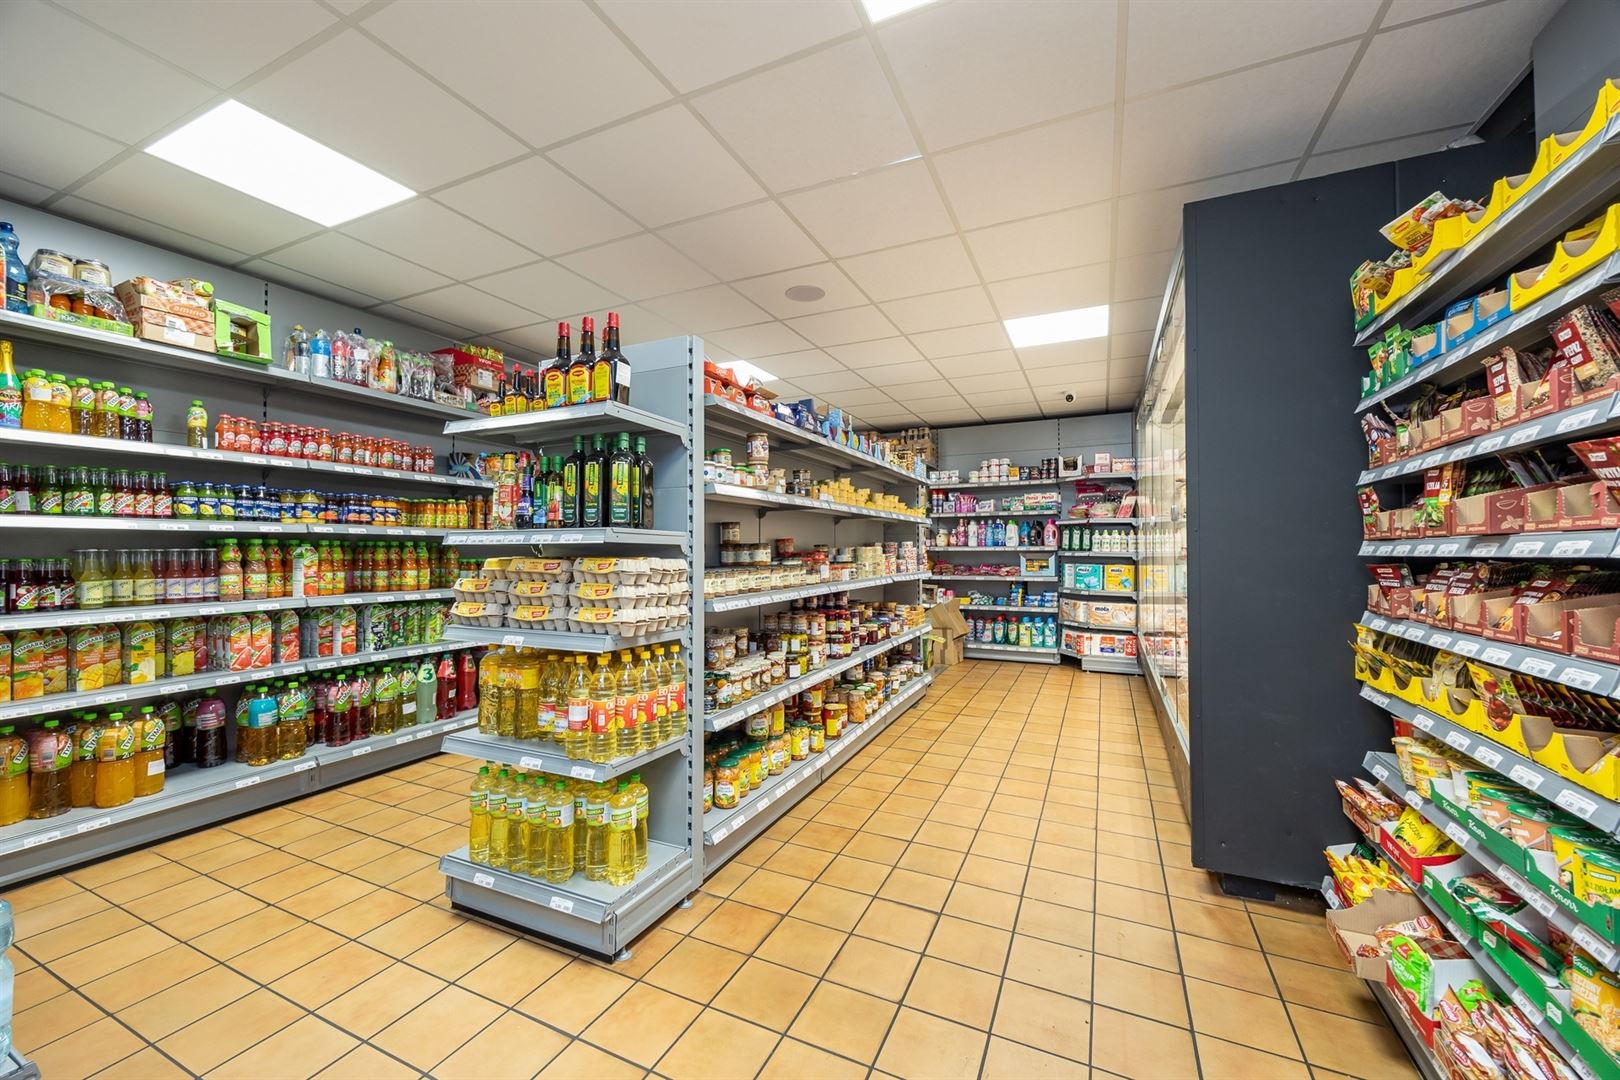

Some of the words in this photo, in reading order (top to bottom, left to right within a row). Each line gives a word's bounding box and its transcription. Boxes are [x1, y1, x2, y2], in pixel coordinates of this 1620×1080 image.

[174, 305, 206, 317] amino
[14, 640, 44, 657] TYMBARK
[76, 635, 103, 651] TYMBARK
[423, 668, 433, 681] 3
[1467, 818, 1488, 840] Knorr
[1549, 883, 1579, 913] Knorr
[1573, 954, 1594, 977] Knorr
